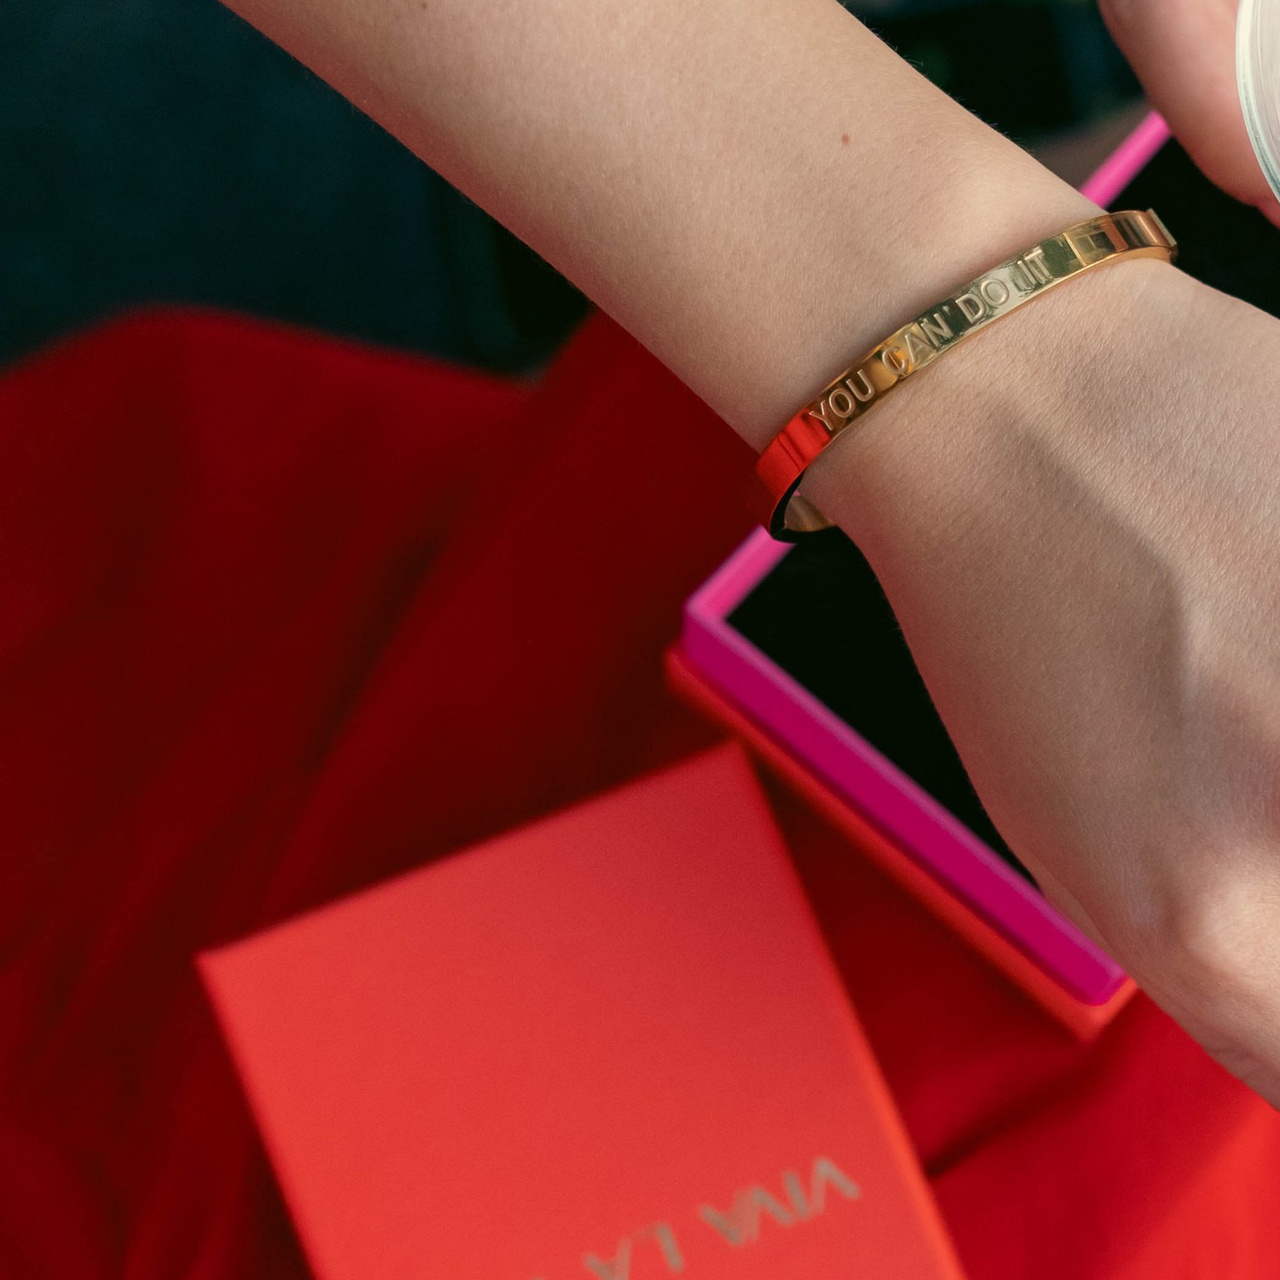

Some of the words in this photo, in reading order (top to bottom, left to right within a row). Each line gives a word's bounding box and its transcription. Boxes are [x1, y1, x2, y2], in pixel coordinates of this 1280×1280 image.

[808, 369, 875, 432] YOU
[881, 305, 955, 375] CAN
[956, 277, 1011, 322] DO
[1016, 247, 1056, 288] IT
[698, 1155, 861, 1247] VIVA
